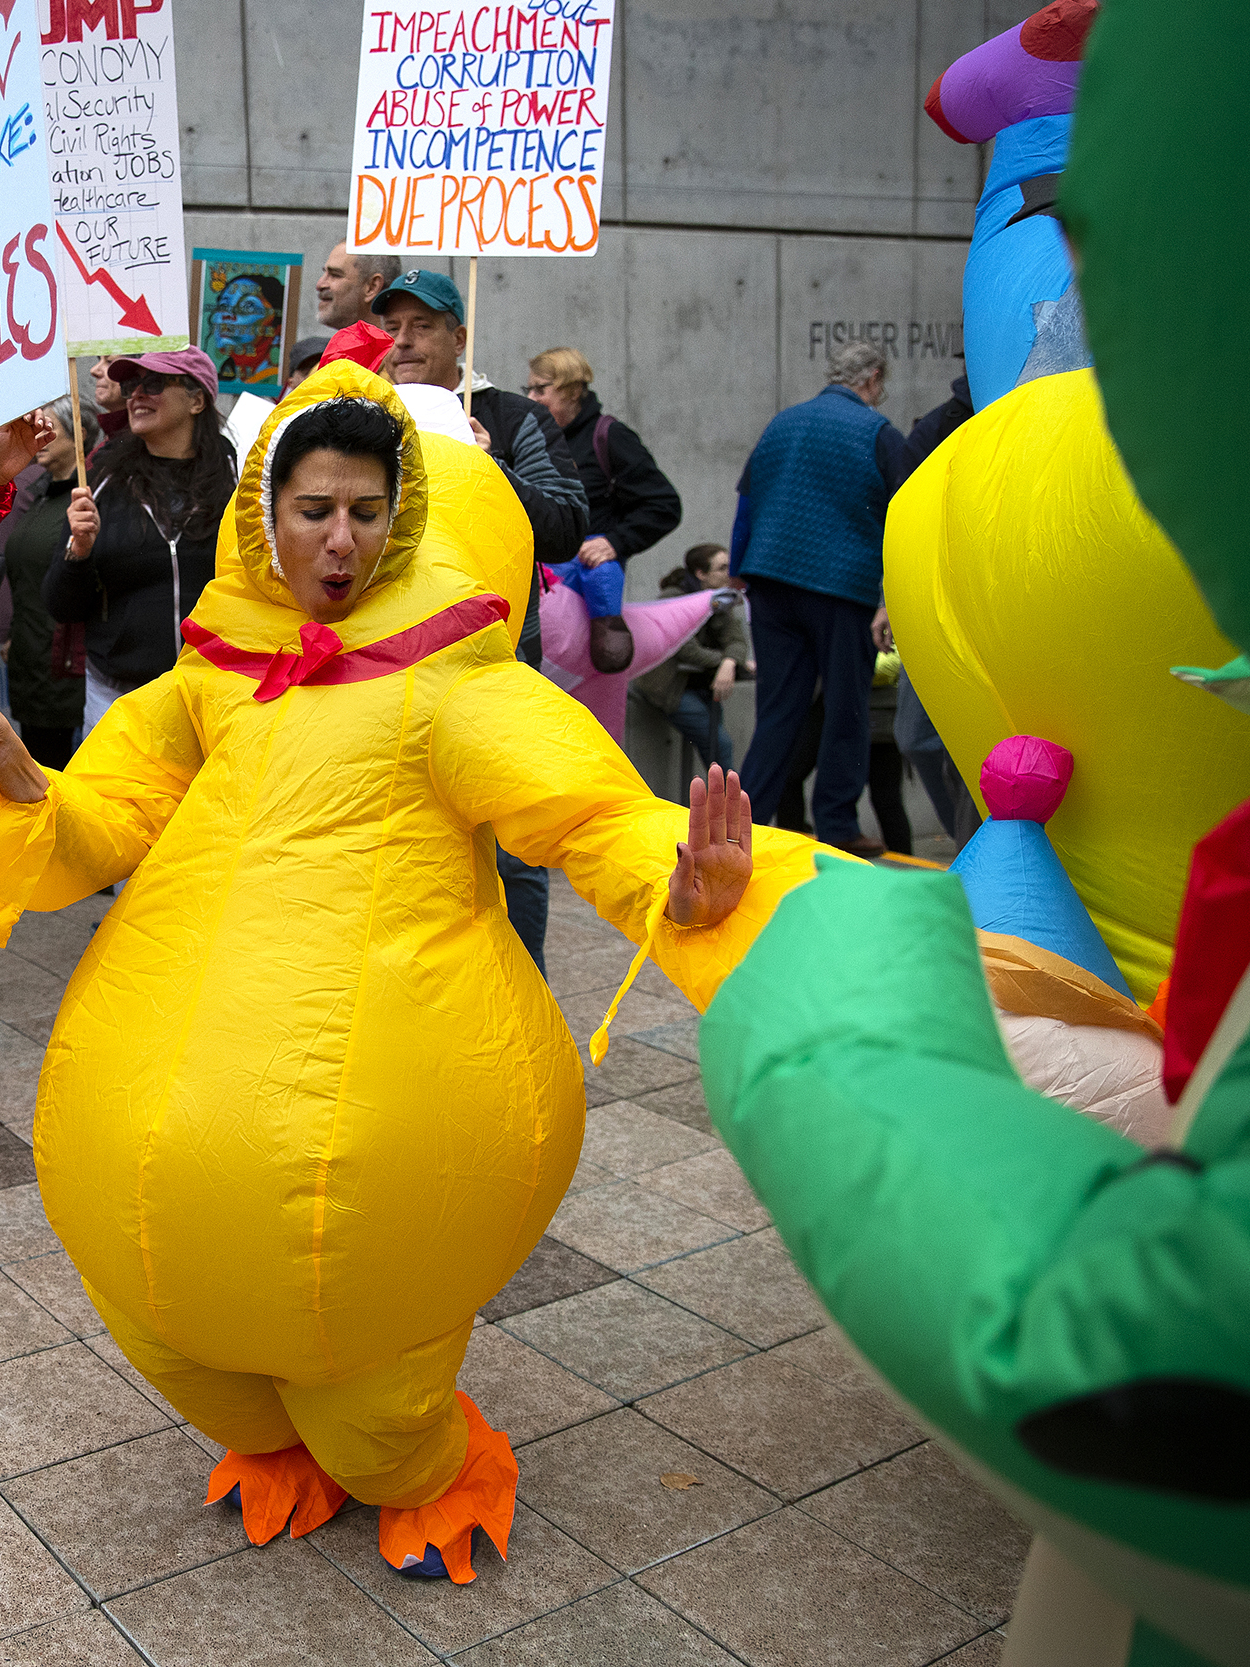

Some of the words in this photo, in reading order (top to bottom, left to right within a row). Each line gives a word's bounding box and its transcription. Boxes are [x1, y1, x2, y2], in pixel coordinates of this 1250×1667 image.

[369, 5, 611, 53] IMPEACHMENT
[396, 47, 598, 90] CORRUPTION
[62, 85, 155, 132] Security
[366, 88, 470, 128] ABUSE
[472, 92, 492, 126] of
[500, 87, 605, 128] POWER
[50, 123, 87, 155] Civil
[93, 122, 156, 165] Rights
[114, 150, 175, 180] JOBS
[364, 126, 602, 173] INCOMPETENCE
[76, 216, 120, 243] OUR
[354, 173, 435, 248] DUE
[438, 172, 600, 253] PROCESS
[86, 236, 171, 266] FUTURE
